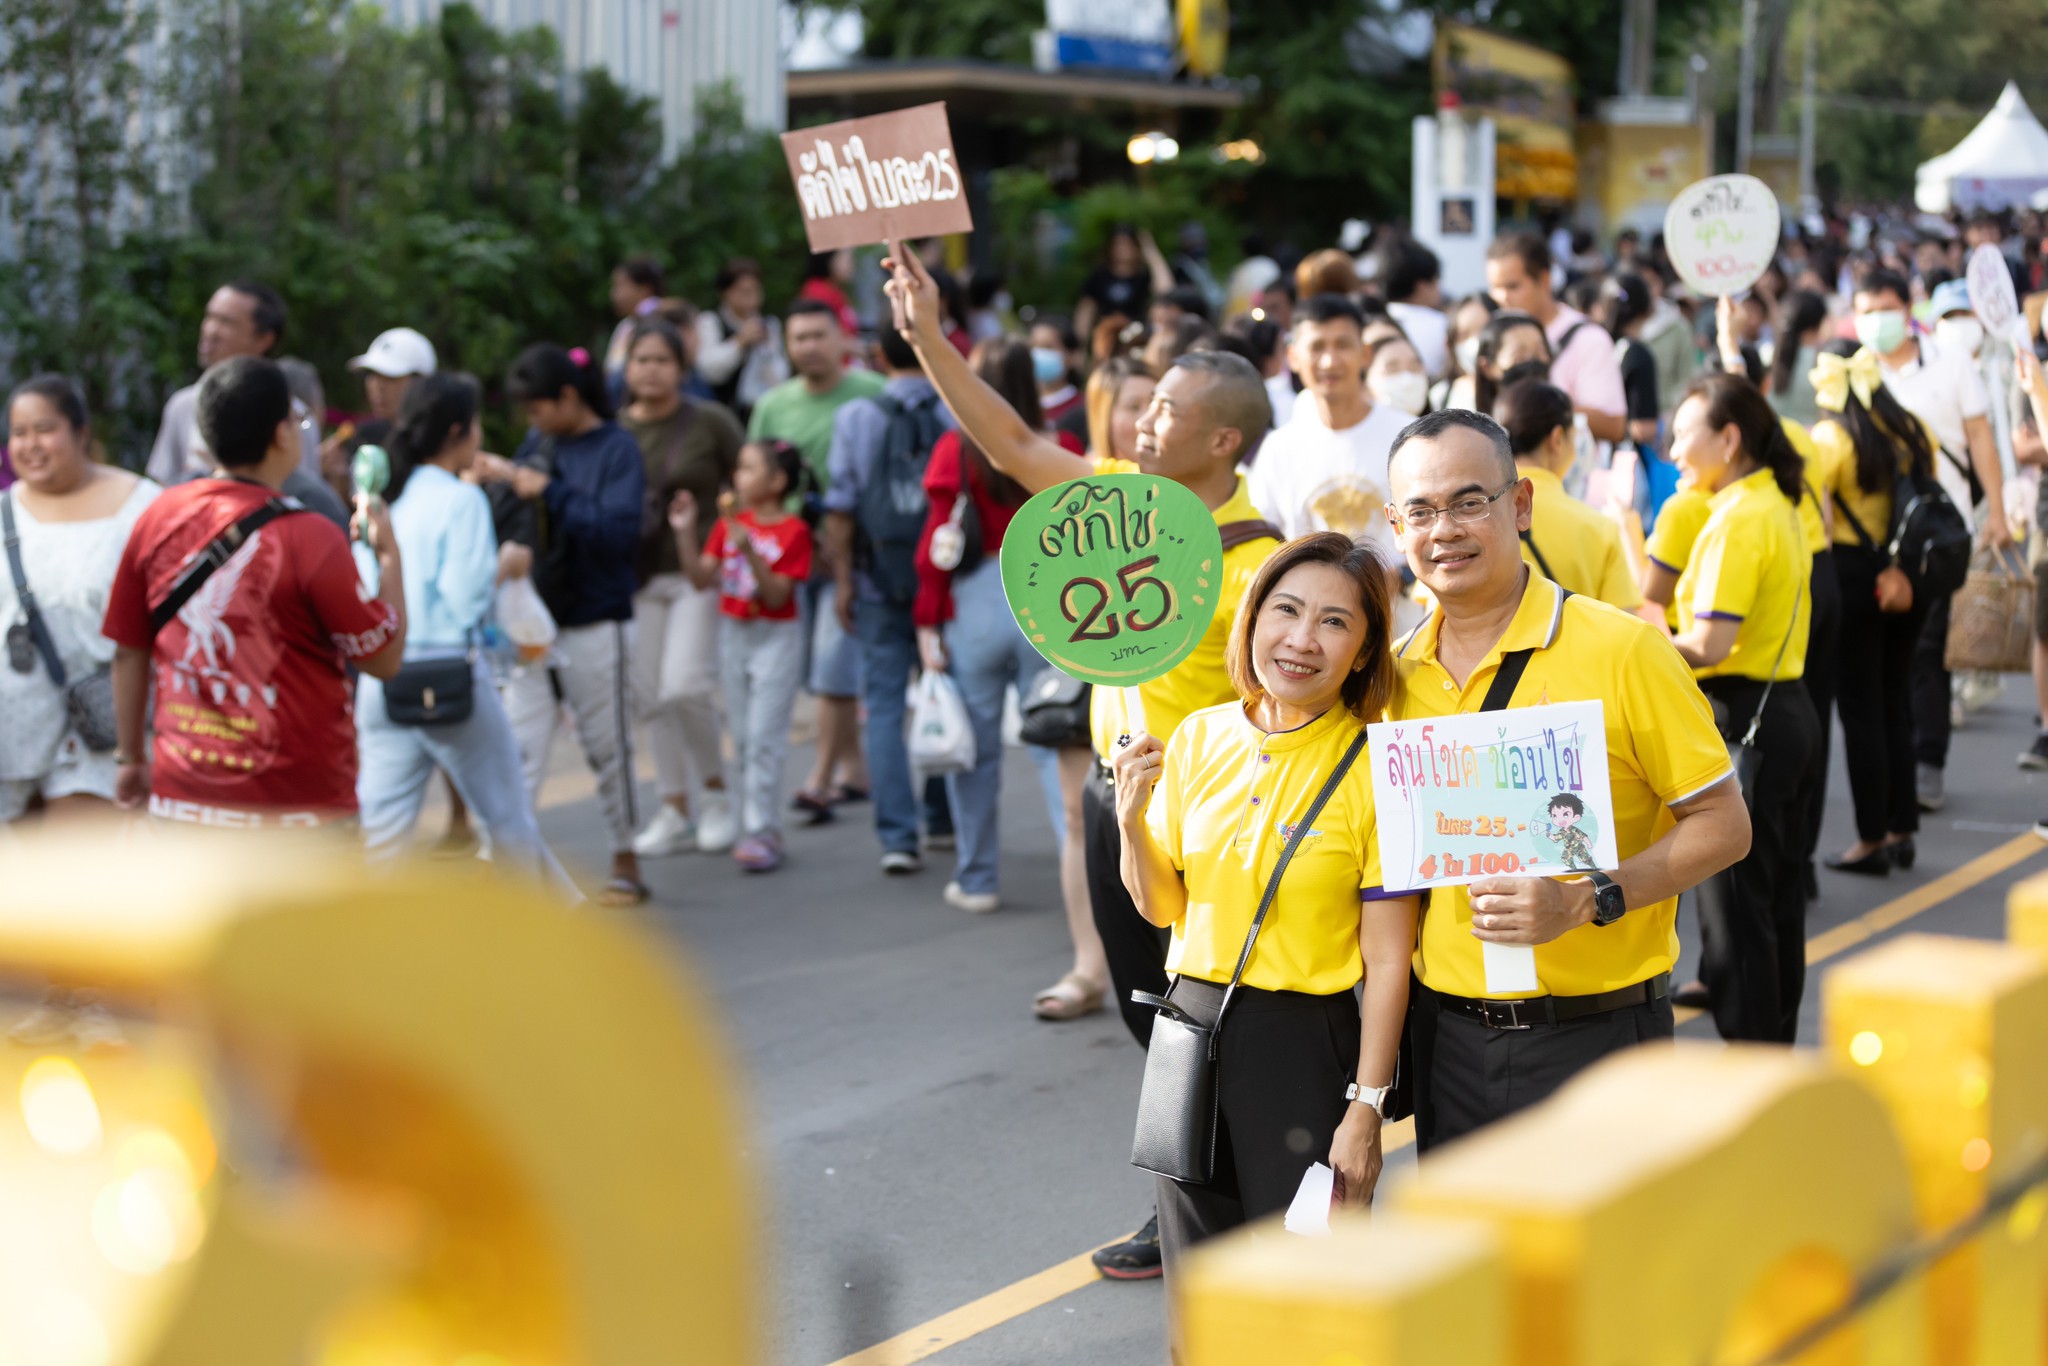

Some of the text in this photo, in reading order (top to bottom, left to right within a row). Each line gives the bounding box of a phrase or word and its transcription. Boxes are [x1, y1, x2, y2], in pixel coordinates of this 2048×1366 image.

[1060, 555, 1172, 642] 25
[1387, 725, 1583, 801] ลุ้นโชค ช้อนไข่
[1435, 810, 1472, 836] ใบละ
[1419, 854, 1438, 879] 4
[1442, 852, 1464, 877] ใบ
